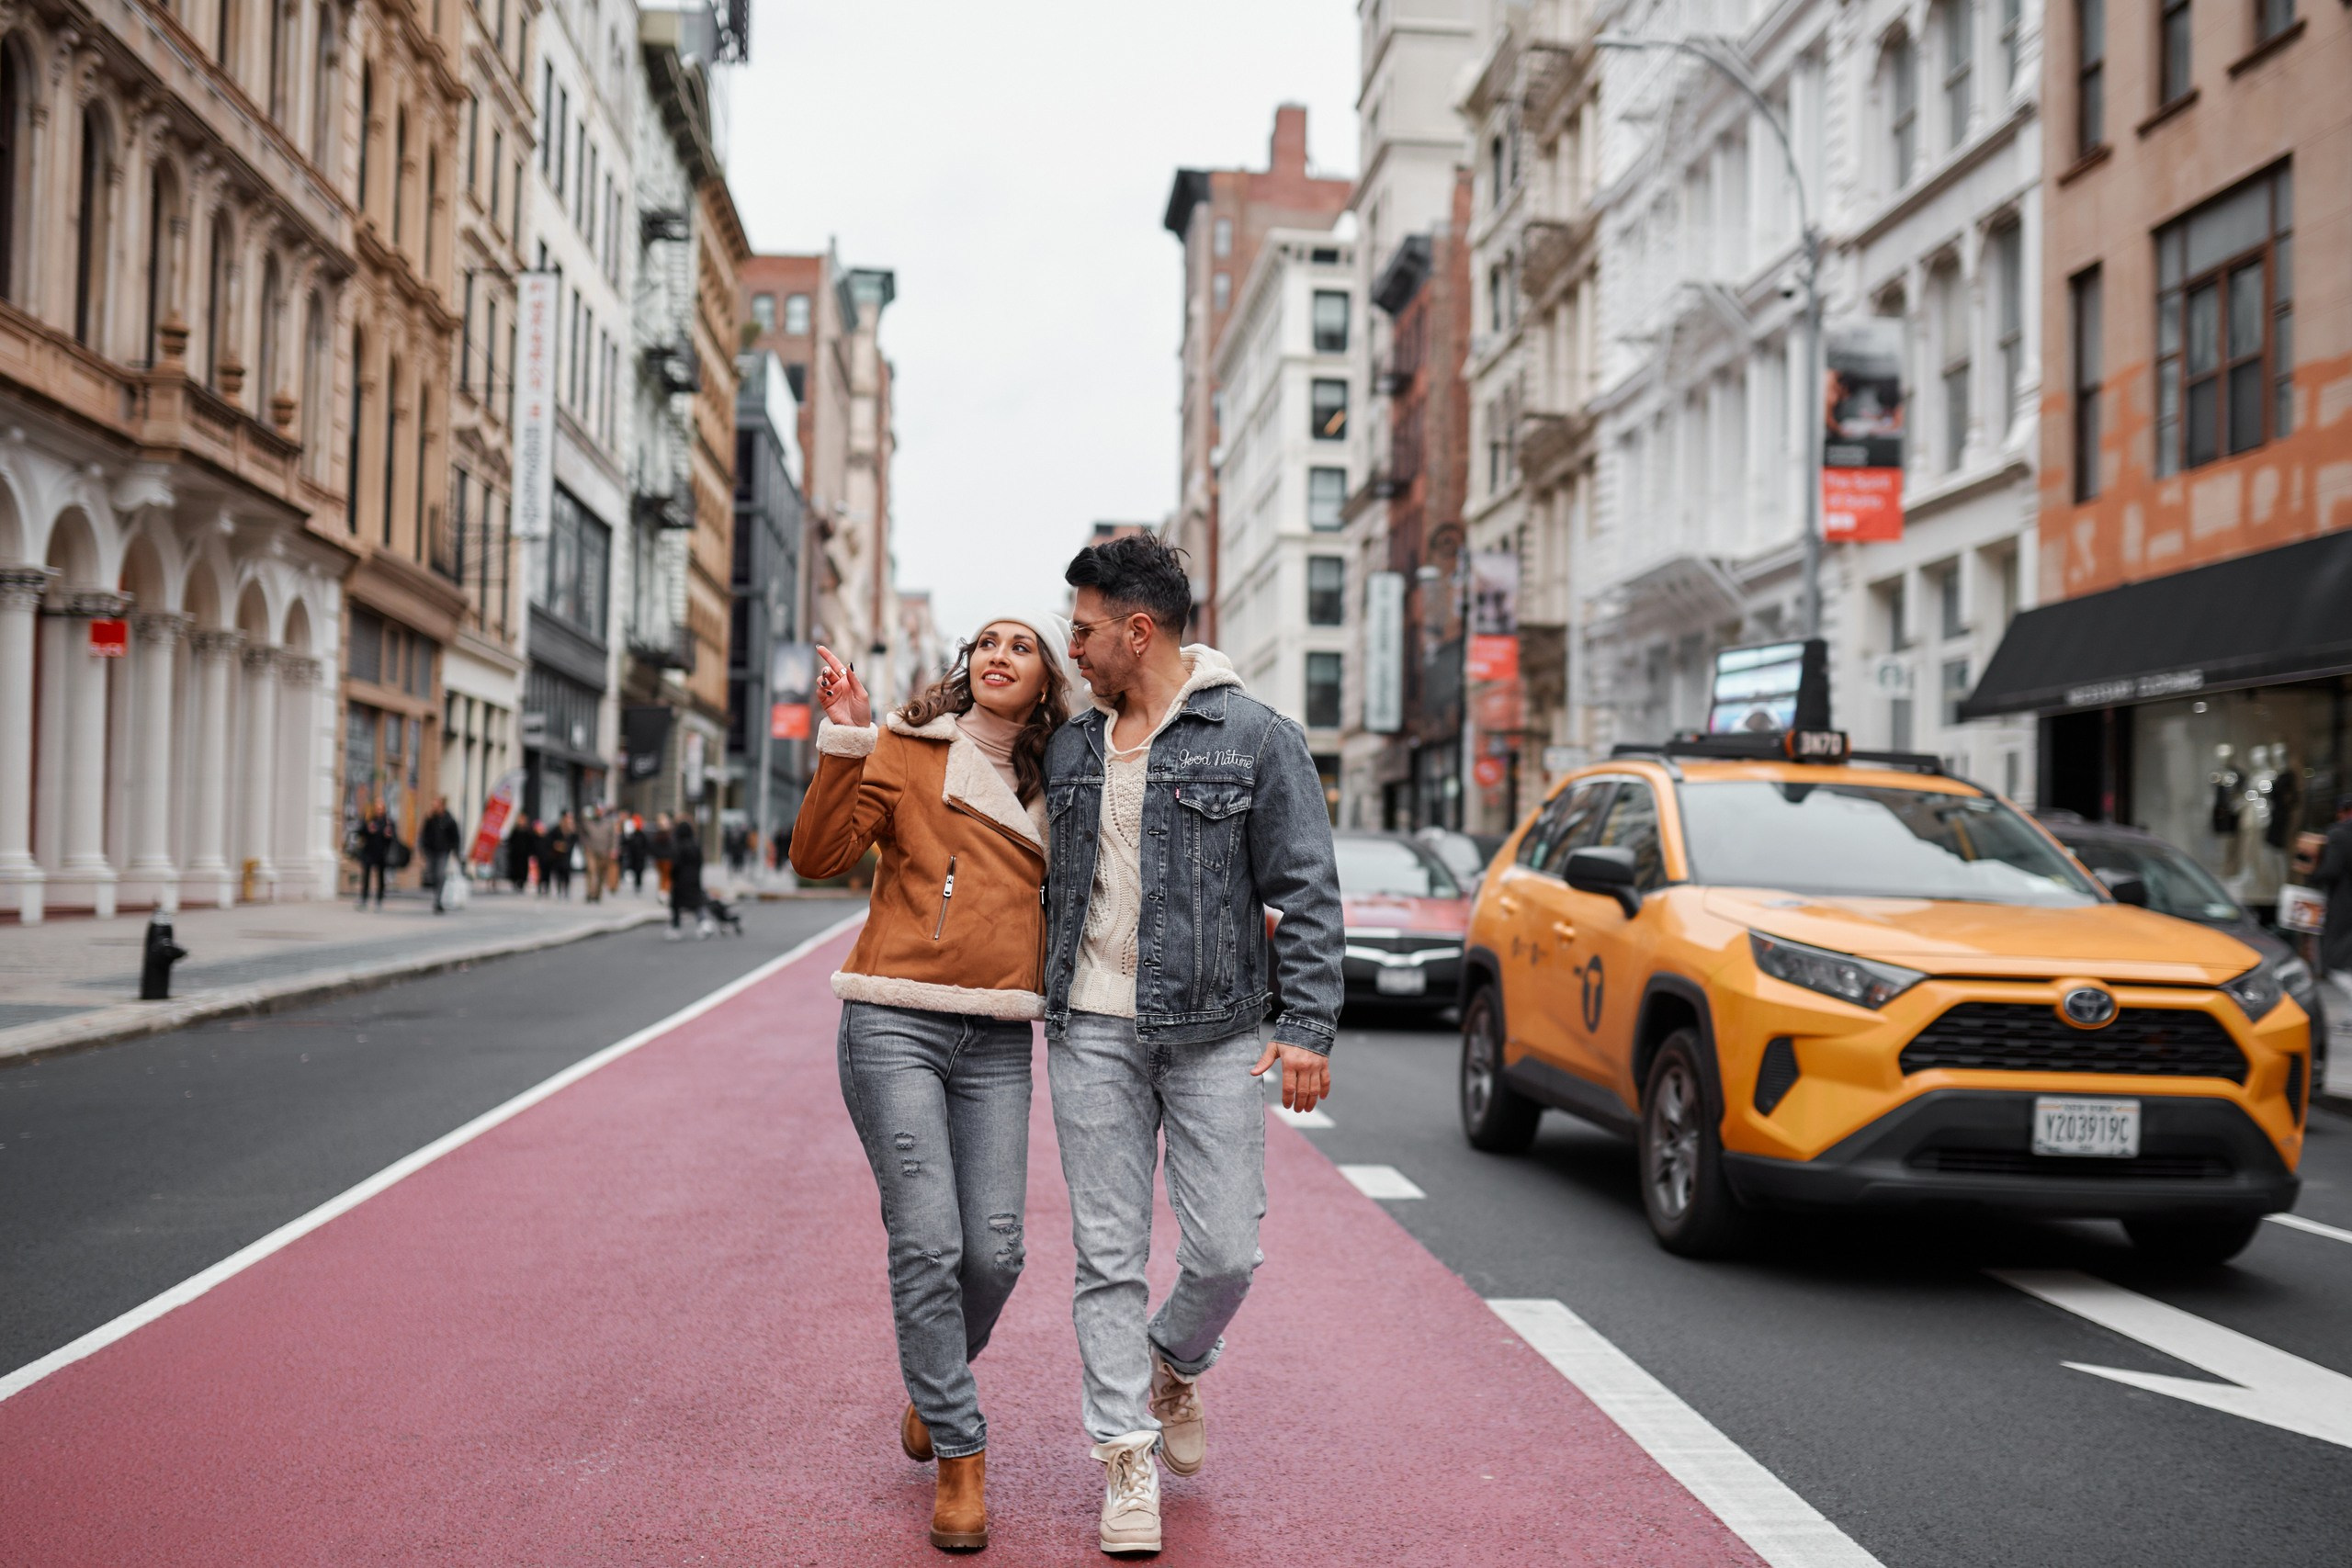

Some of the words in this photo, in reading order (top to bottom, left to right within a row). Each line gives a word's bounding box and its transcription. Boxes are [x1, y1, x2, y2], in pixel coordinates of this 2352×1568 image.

[1179, 749, 1211, 768] Good
[1214, 750, 1255, 769] Nature
[2045, 1113, 2130, 1145] Y203919C
